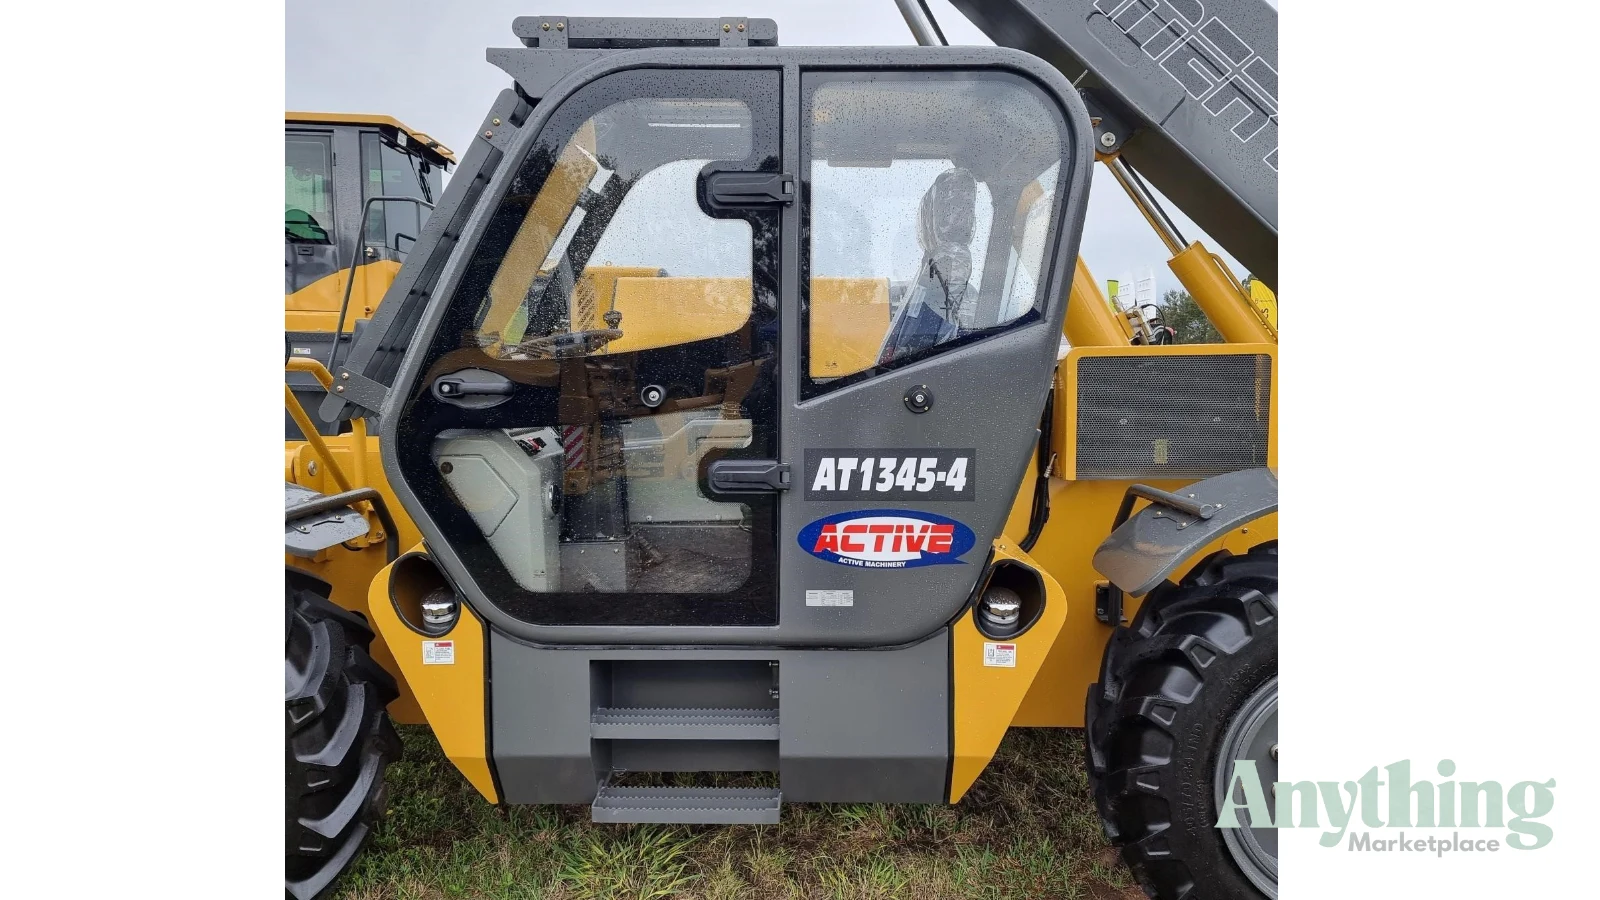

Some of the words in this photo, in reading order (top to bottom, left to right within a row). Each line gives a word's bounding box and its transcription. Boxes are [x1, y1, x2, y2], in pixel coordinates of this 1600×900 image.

[811, 457, 968, 492] AT1345-4
[813, 523, 955, 553] ACTIVE
[838, 557, 864, 567] ACTIVE
[865, 560, 906, 568] MACHINERY
